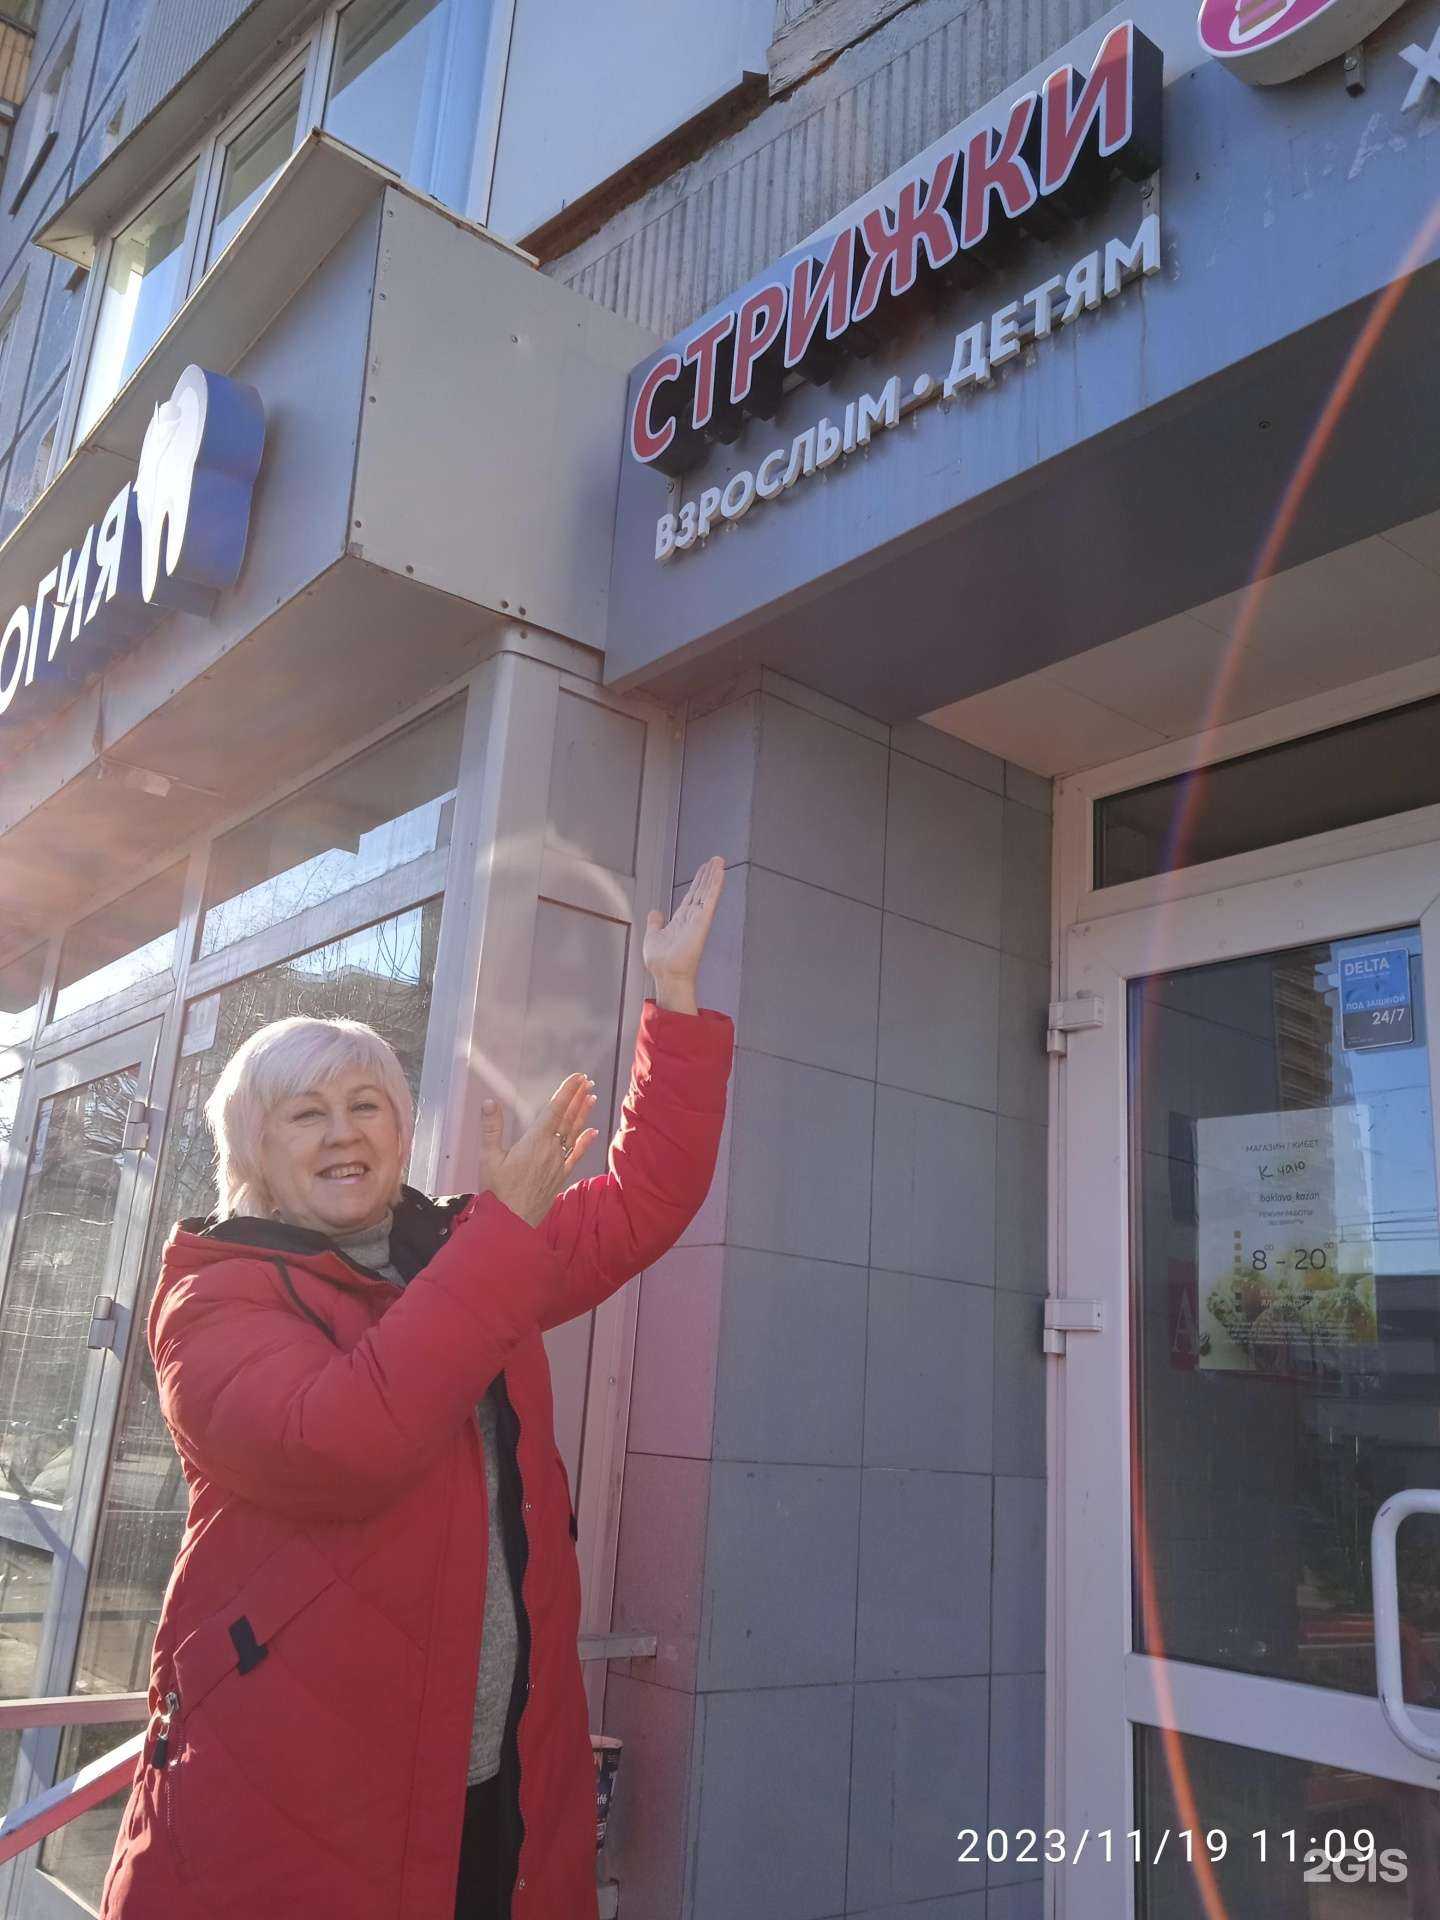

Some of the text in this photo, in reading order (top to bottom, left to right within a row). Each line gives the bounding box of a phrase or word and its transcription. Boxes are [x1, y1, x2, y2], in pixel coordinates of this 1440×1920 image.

[631, 20, 1134, 464] СТРИЖКИ
[654, 213, 1161, 561] ВЗРОСЛЫМ ДЕТЯМ
[1344, 957, 1390, 976] DELTA
[1372, 1007, 1405, 1025] 24/7
[1245, 1143, 1285, 1153] МАГАЗИН
[1258, 1161, 1306, 1180] К чаю
